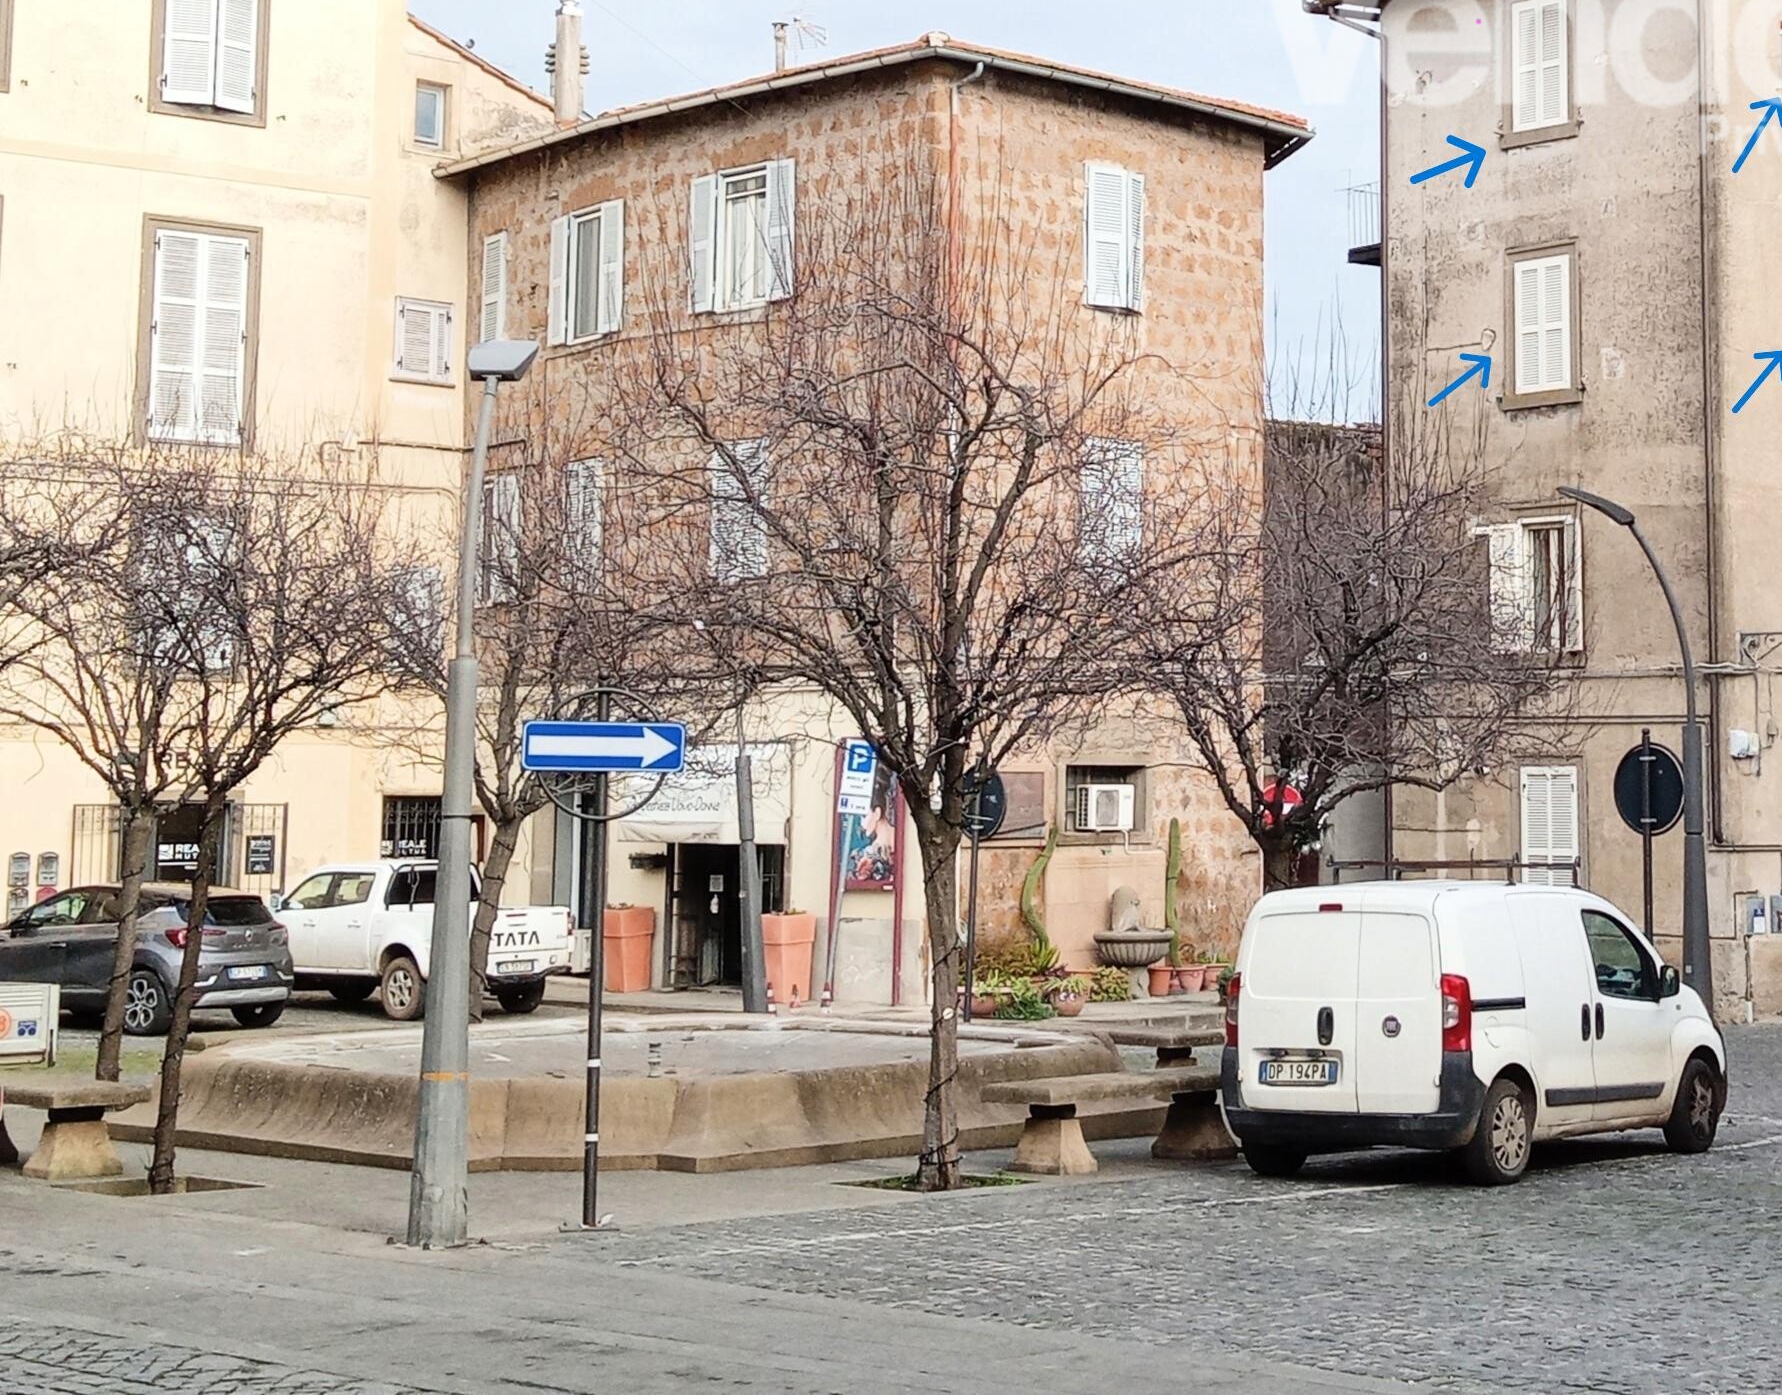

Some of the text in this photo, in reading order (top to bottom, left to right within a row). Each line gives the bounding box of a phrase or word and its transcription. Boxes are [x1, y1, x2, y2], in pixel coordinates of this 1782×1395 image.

[851, 747, 869, 770] P
[175, 843, 200, 854] REA
[494, 930, 540, 947] TATA
[1268, 1064, 1327, 1080] DP 194PA
